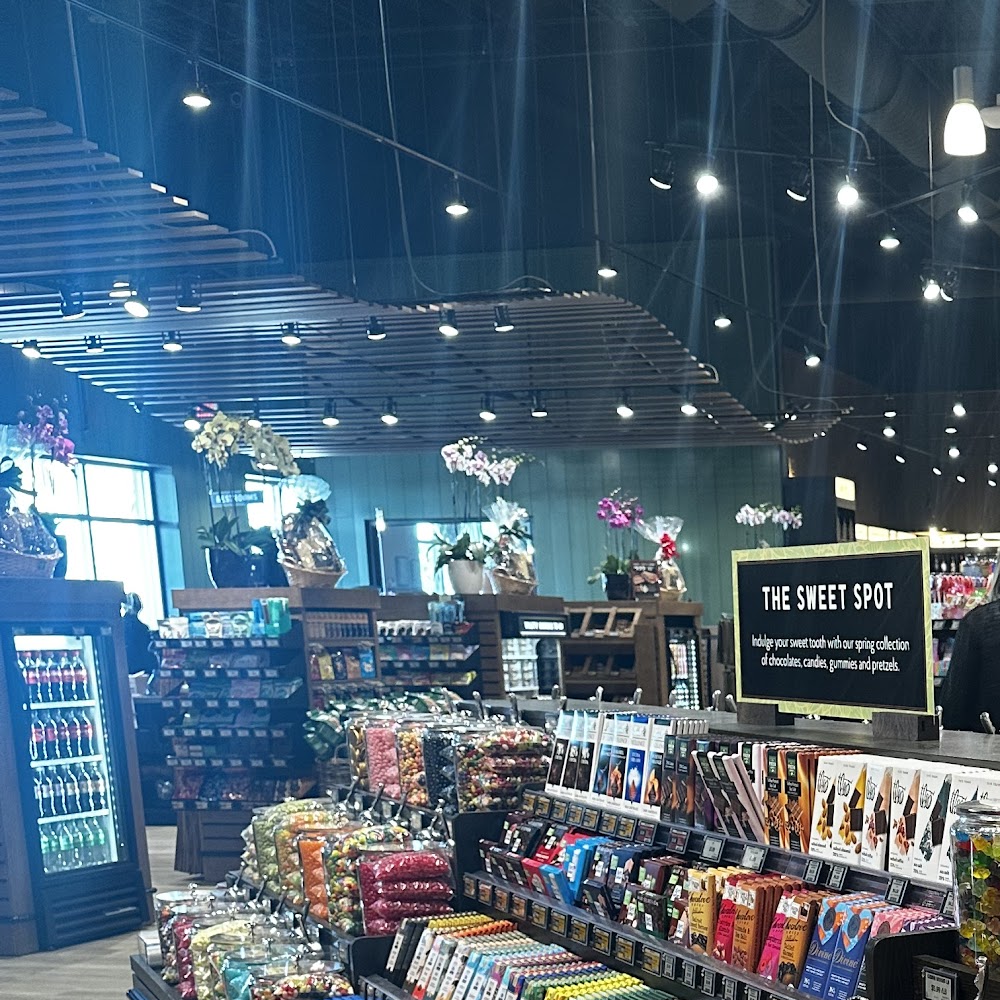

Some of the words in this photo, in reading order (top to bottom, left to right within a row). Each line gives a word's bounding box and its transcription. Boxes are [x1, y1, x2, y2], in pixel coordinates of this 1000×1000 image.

[762, 586, 790, 611] THE
[796, 583, 847, 611] SWEET
[853, 582, 894, 610] SPOT
[752, 634, 774, 651] Indulge
[774, 638, 789, 651] your
[790, 638, 808, 648] sweet
[809, 635, 826, 649] tooth
[827, 636, 842, 650] with
[842, 639, 854, 650] our
[855, 636, 875, 654] spring
[876, 636, 910, 651] collection
[761, 654, 768, 666] of
[768, 654, 802, 668] chocolates,
[803, 656, 828, 670] candies,
[829, 658, 858, 672] gummies
[858, 657, 871, 670] and
[872, 658, 900, 674] pretzels.
[808, 941, 832, 960] Divine
[834, 950, 858, 970] Divine
